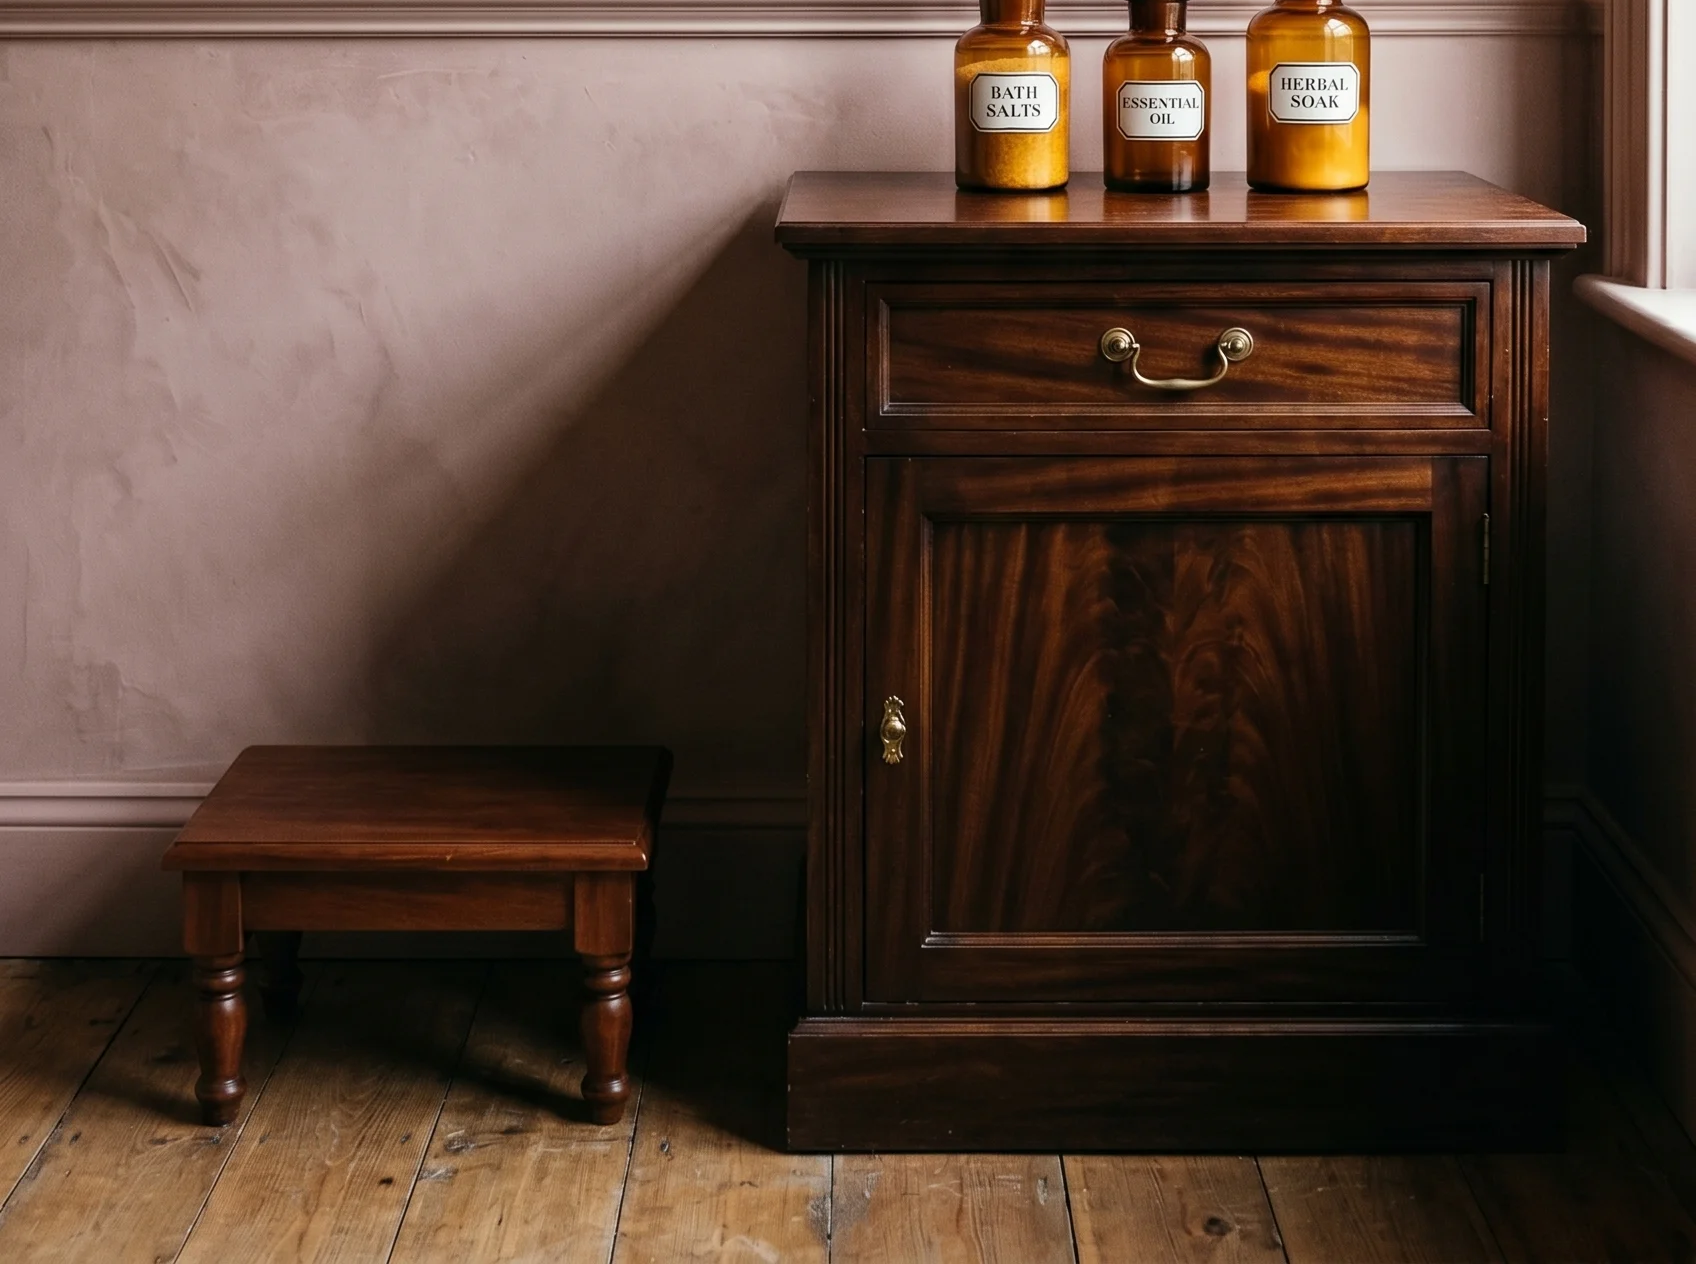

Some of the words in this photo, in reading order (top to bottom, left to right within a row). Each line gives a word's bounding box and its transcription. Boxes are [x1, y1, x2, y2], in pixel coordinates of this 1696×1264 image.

[1281, 77, 1348, 91] HERBAL
[991, 86, 1037, 99] BATH
[1122, 97, 1199, 109] ESSENTIAL
[1290, 94, 1339, 109] SOAK
[986, 103, 1041, 118] SALTS
[1149, 112, 1175, 125] OIL
